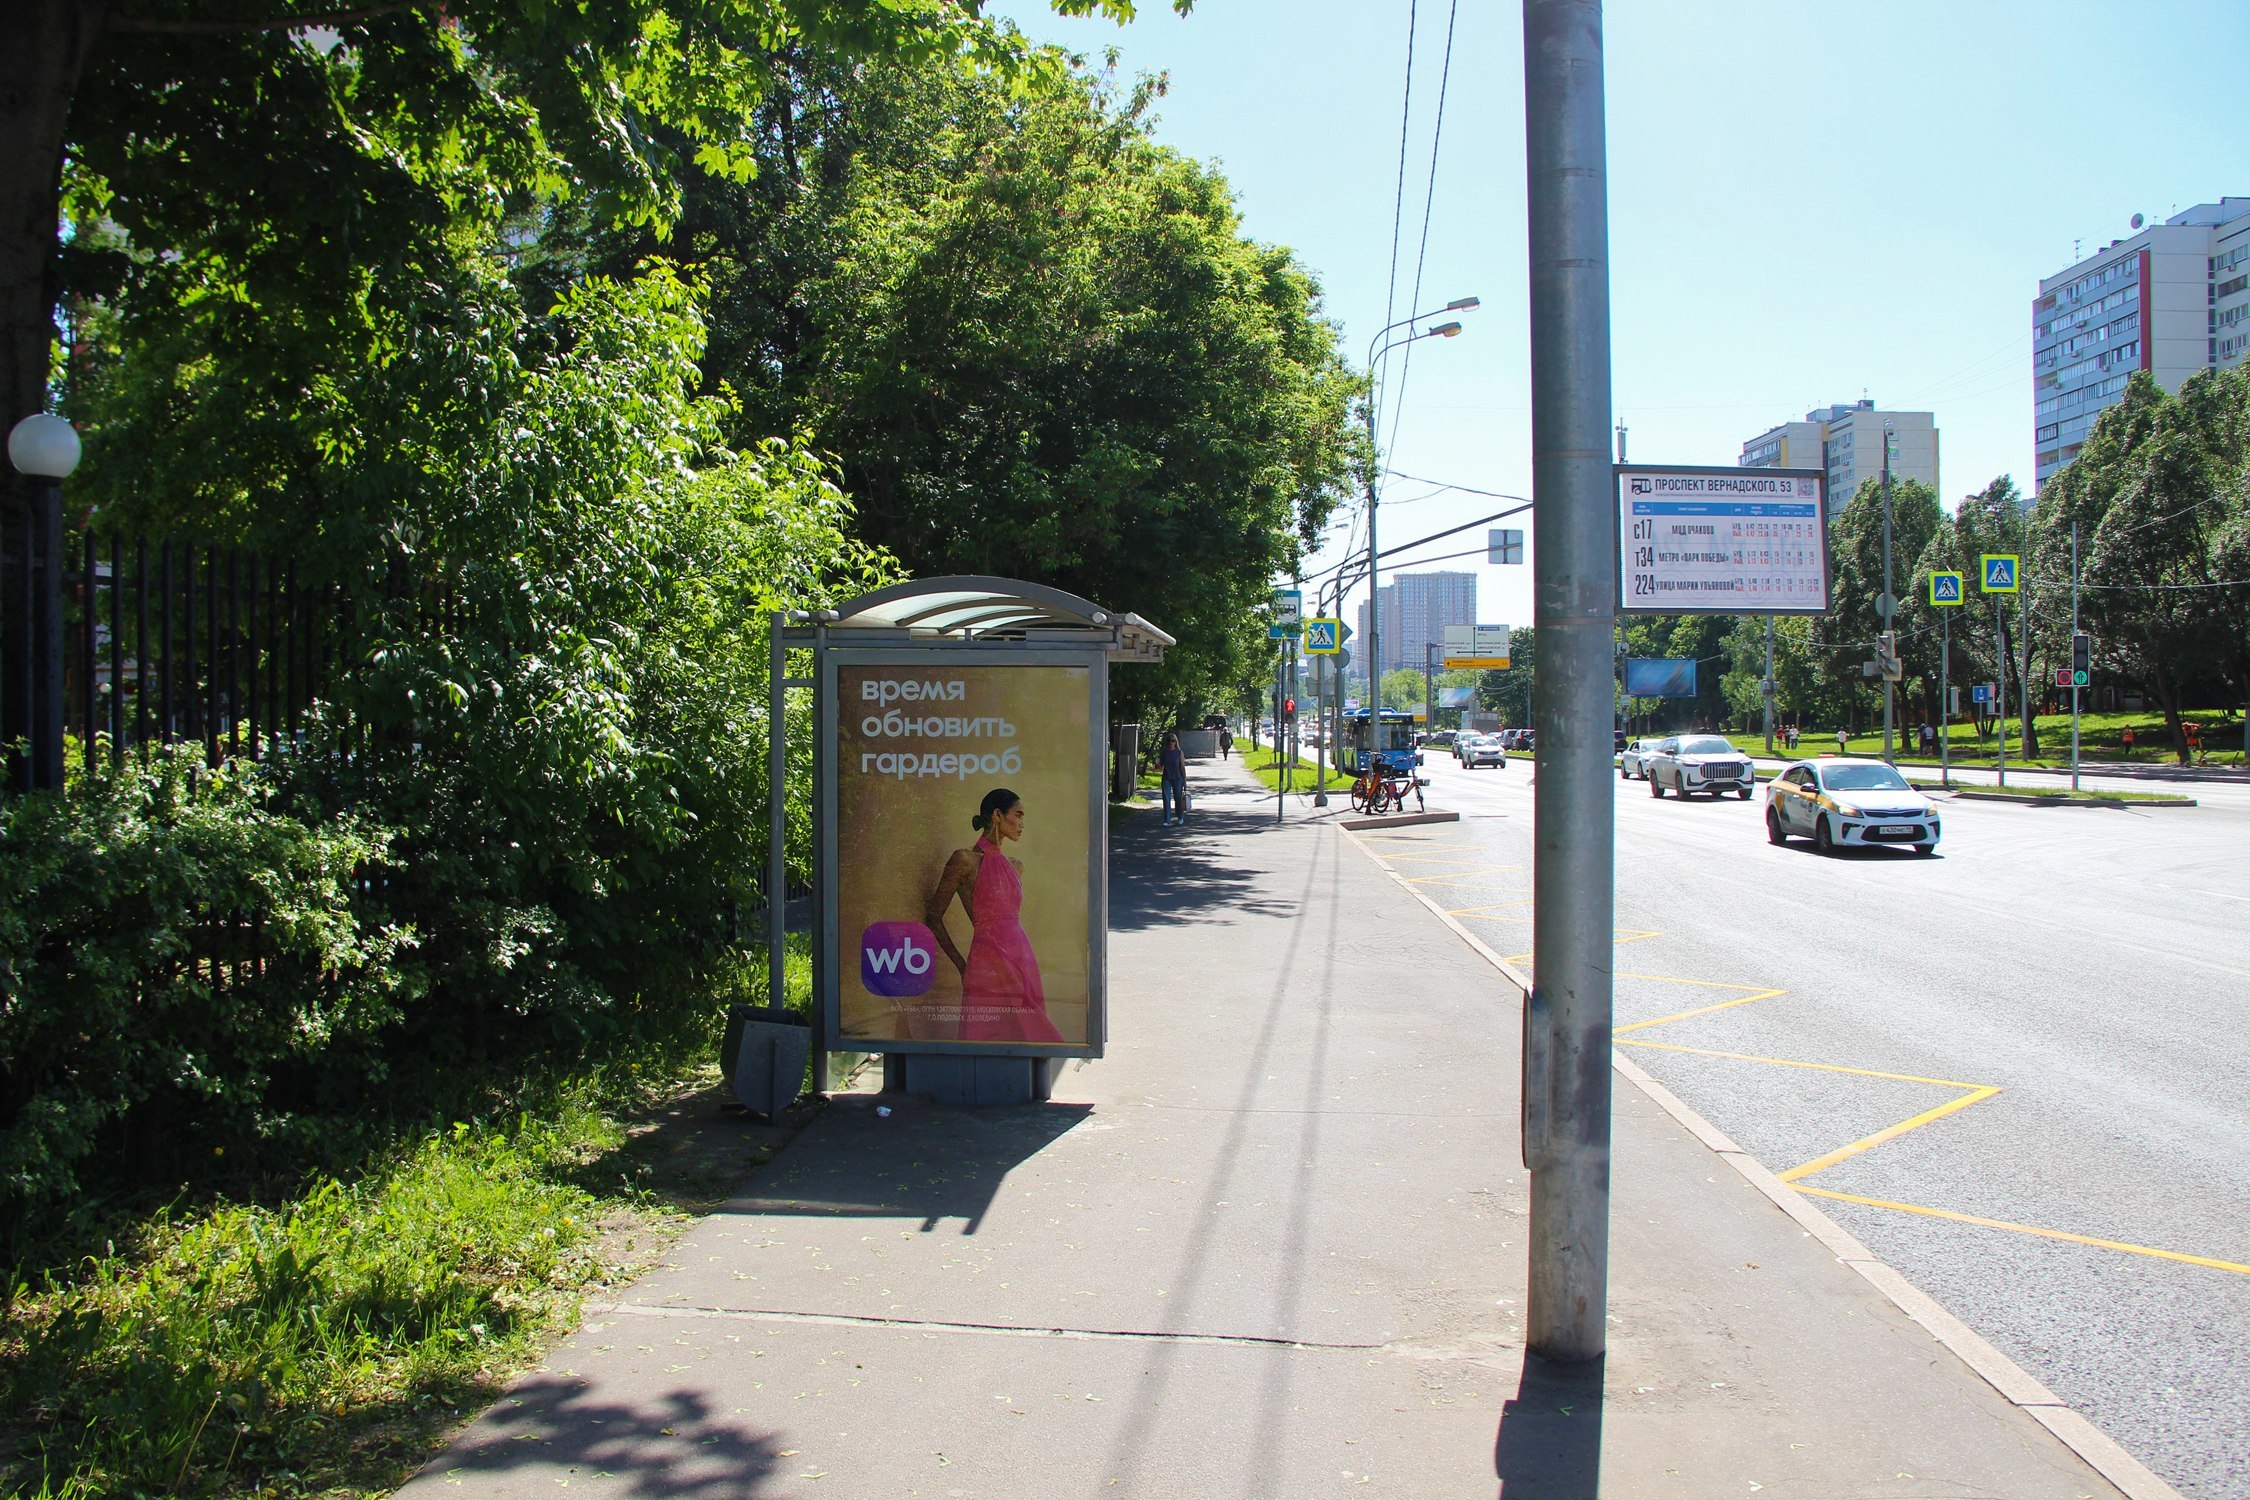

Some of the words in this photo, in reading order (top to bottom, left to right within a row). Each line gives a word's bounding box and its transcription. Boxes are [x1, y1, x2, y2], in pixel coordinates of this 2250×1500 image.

[1655, 479, 1704, 491] ПРОСПЕКТ
[1708, 479, 1778, 493] ВЕРНАДСКОГО,
[1780, 481, 1792, 492] 53
[1634, 519, 1652, 539] с17
[1687, 525, 1714, 535] ОЧАКОВО
[1634, 546, 1653, 567] т34
[1658, 552, 1679, 562] МЕТРО
[1635, 574, 1654, 595] 224
[1655, 581, 1675, 591] УЛИЦА
[1676, 581, 1699, 590] МАРИИ
[1700, 580, 1734, 591] УЛЬЯНОВОЙ
[862, 680, 965, 707] время
[861, 709, 1016, 737] обновить
[861, 746, 1022, 780] гардероб
[865, 937, 931, 975] wb
